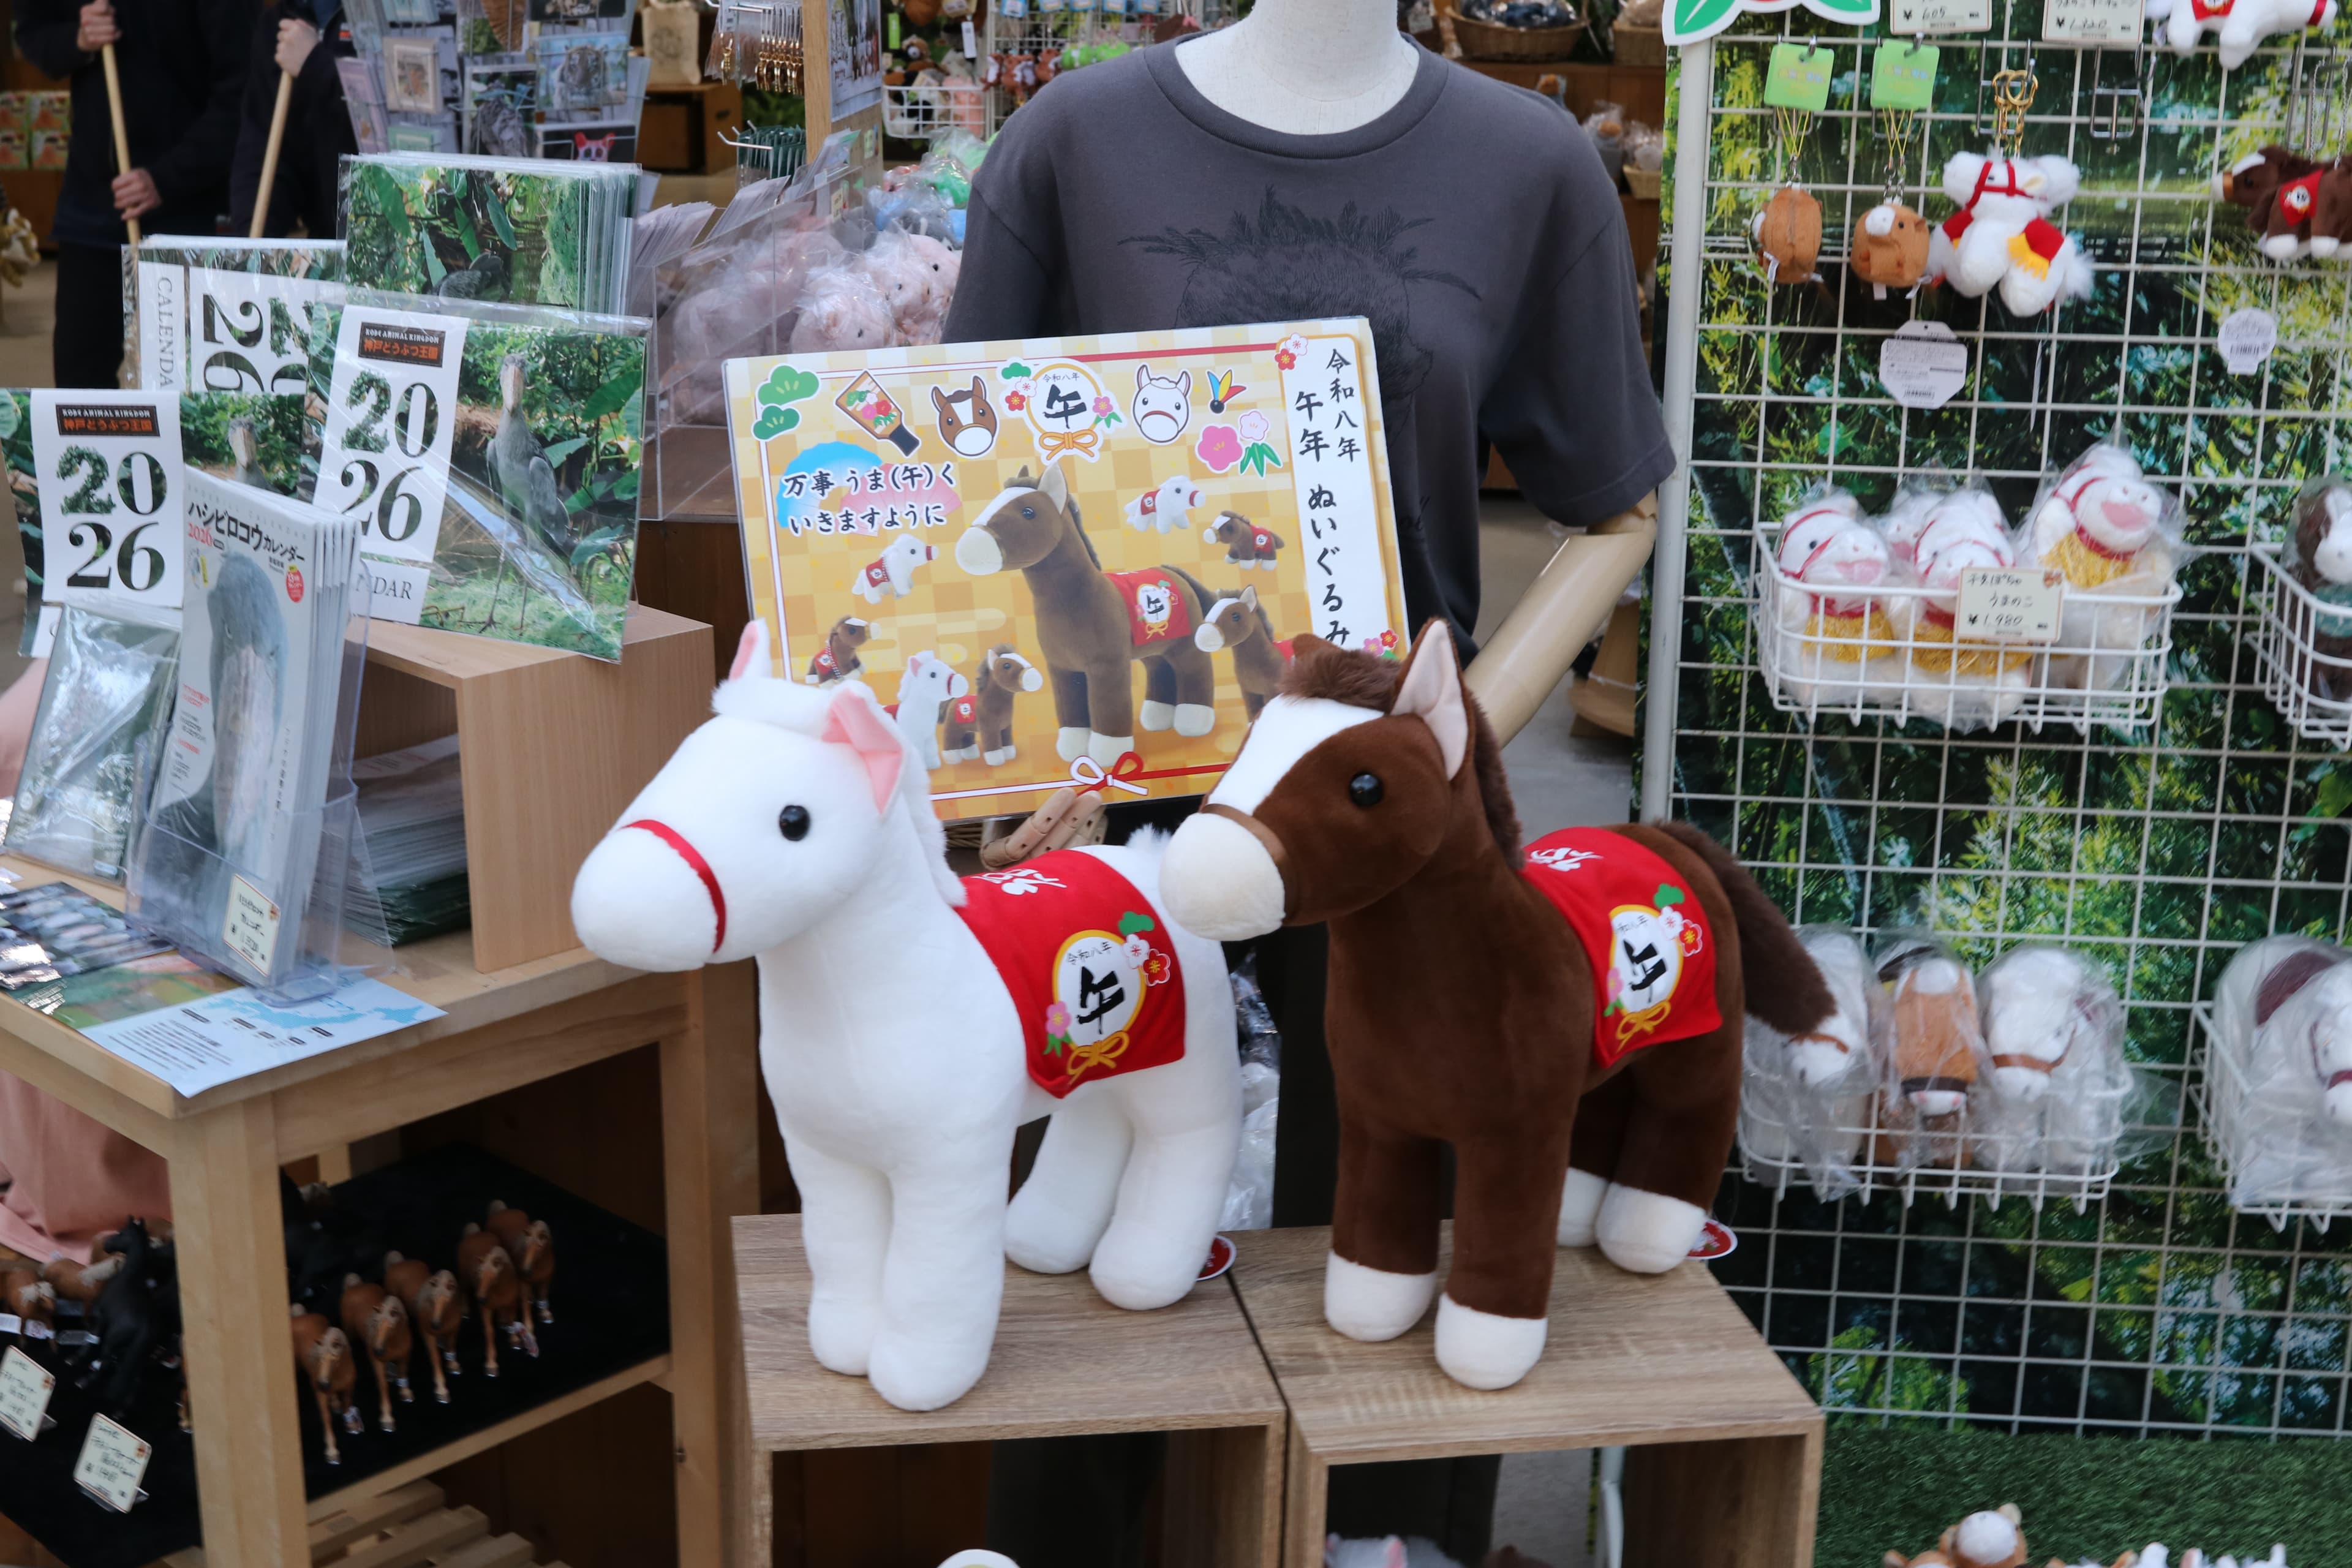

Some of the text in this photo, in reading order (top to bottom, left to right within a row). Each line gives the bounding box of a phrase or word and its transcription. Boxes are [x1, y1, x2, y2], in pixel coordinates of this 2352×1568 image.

[203, 294, 265, 392] 26
[1042, 372, 1080, 383] 令和八年
[341, 369, 439, 458] 20
[1042, 384, 1087, 430] 午
[1326, 349, 1362, 463] 令和八年
[56, 444, 167, 515] 20
[341, 460, 424, 542] 26
[784, 469, 835, 497] 万事
[188, 522, 213, 548] 2026
[790, 503, 944, 534] いきますように
[1295, 391, 1350, 646] 午年 ぬいぐるみ
[67, 522, 165, 590] 26
[1076, 966, 1126, 1035] 午
